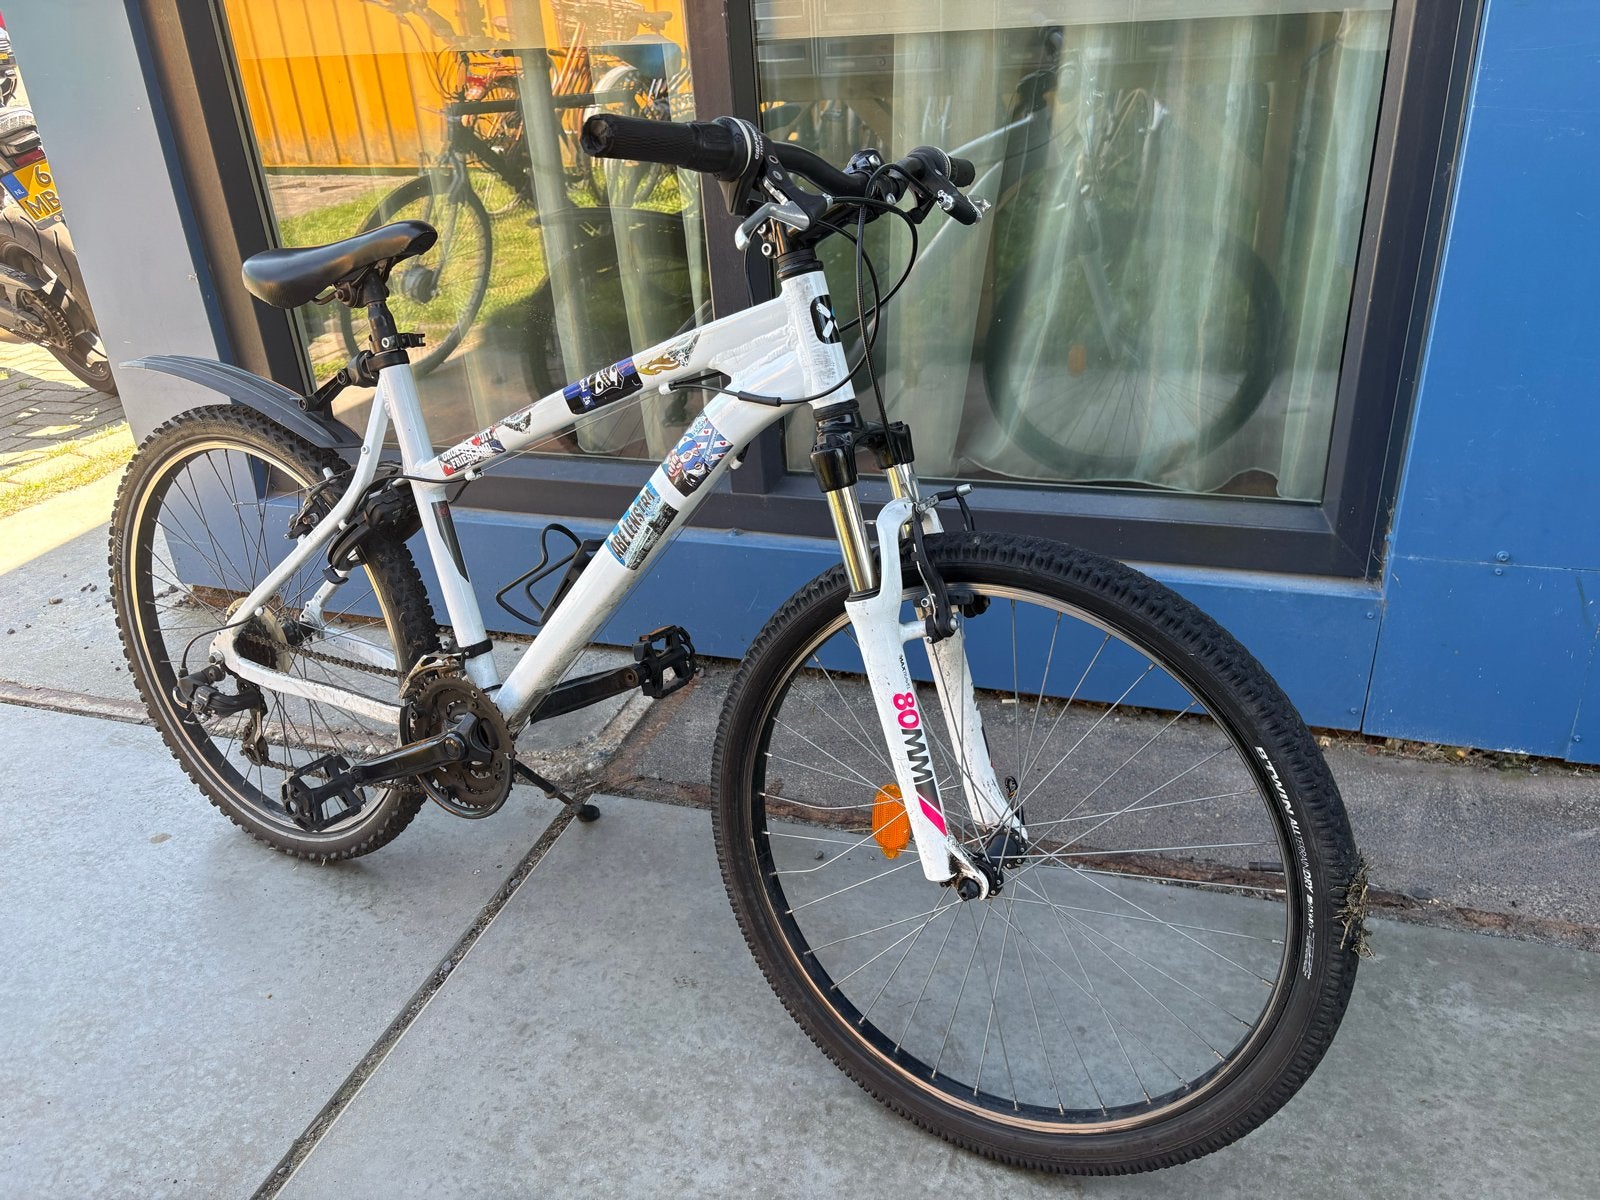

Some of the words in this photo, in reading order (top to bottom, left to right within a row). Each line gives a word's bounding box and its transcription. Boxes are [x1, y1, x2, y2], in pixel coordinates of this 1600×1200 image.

[34, 165, 52, 187] 6
[14, 188, 25, 196] NL
[25, 189, 61, 220] MB
[610, 529, 631, 558] ABE
[621, 488, 656, 540] LENSTRA
